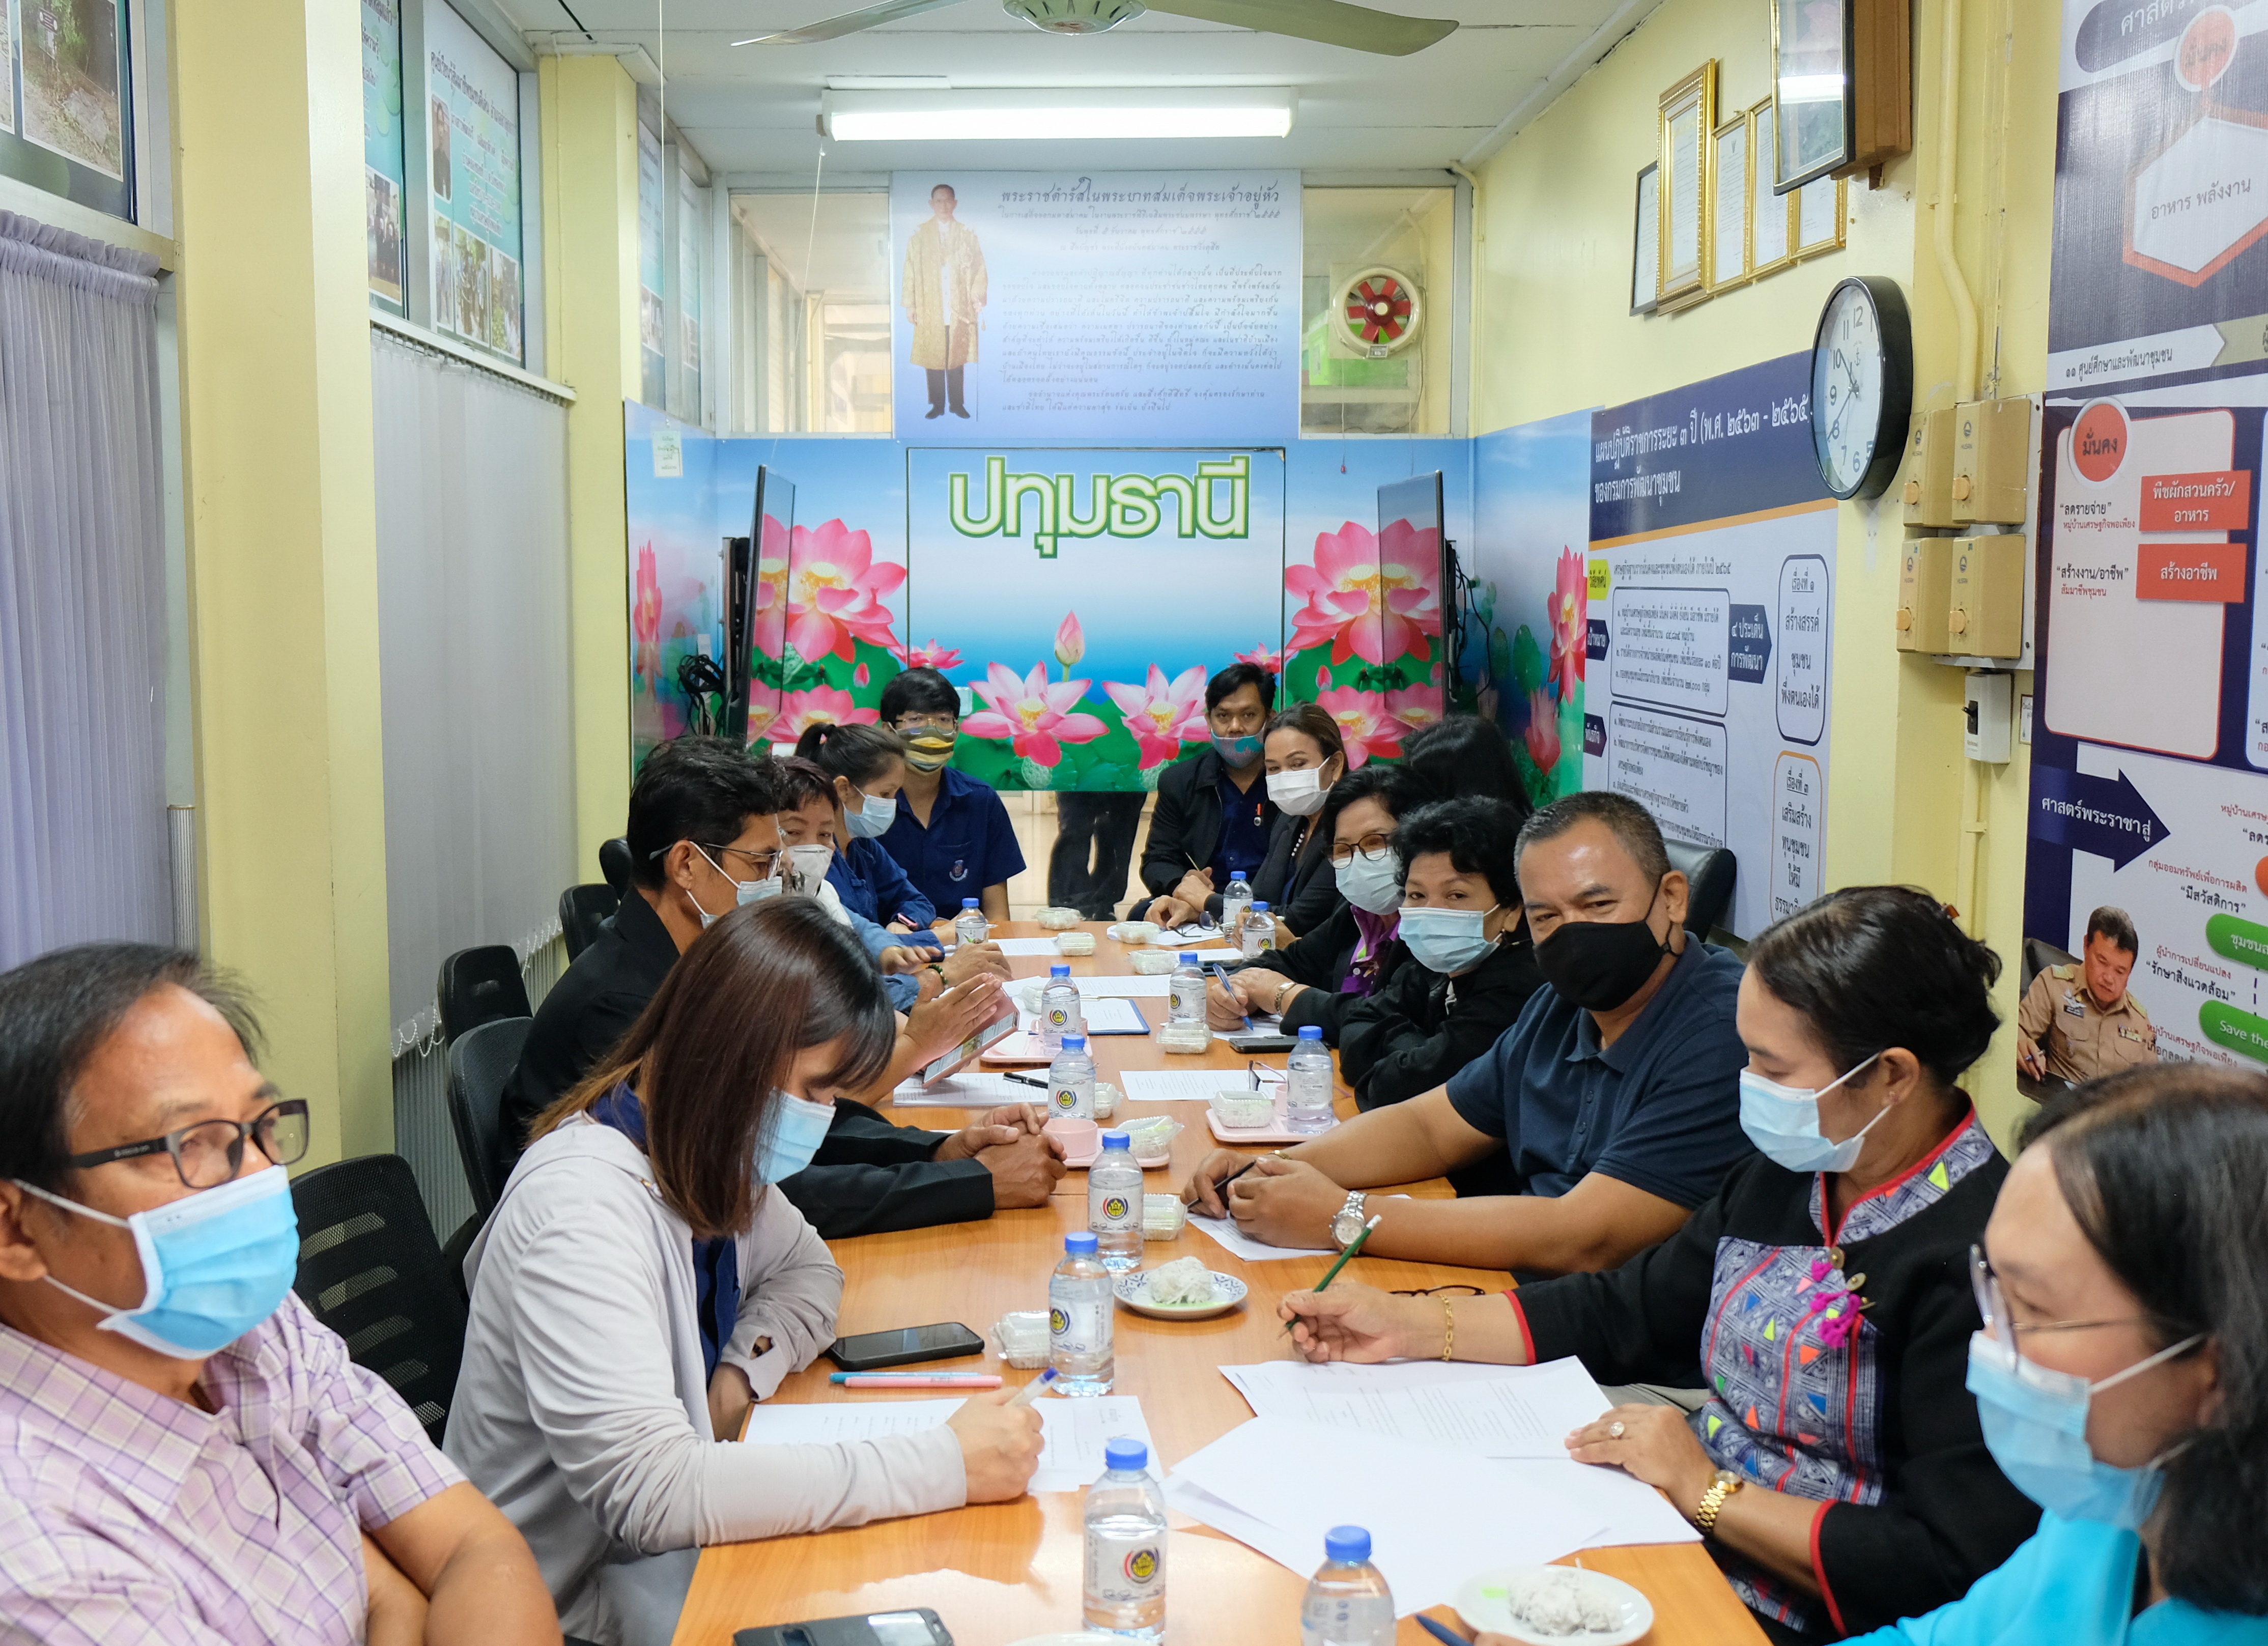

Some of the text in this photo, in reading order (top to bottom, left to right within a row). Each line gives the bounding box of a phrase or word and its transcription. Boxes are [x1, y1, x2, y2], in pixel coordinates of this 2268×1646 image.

[1002, 177, 1279, 209] พระราชดำรัสในพระบาทสมเด็จพระเจ้าอยู่หัว
[2150, 178, 2252, 220] อาหาร พลังงาน
[1853, 305, 1863, 329] 12
[1843, 319, 1849, 341] 11
[1833, 348, 1842, 370] 10
[2078, 349, 2173, 382] ศูนย์ศึกษาและพัฒนาชุมชน
[1829, 385, 1837, 406] 9
[1596, 425, 1678, 470] แผนปฏิบัติราชการระยะ
[1680, 428, 1687, 446] ๓
[1689, 407, 1697, 443] ปี
[1700, 411, 1724, 445] (พ.ศ.
[1727, 409, 1760, 437] ๒๕๖๓
[1772, 393, 1809, 427] ๒๕๖๕
[1832, 419, 1840, 440] 8
[2082, 428, 2118, 456] มั่นคง
[1841, 445, 1848, 466] 7
[1853, 451, 1860, 473] 6
[1595, 465, 1681, 506] ของกรมการพัฒนาชุมชน
[2152, 477, 2236, 500] พืชผักสวนครัว/
[949, 455, 1251, 558] ปทุมธานี
[2174, 508, 2209, 523] อาหาร
[2063, 519, 2136, 534] หมู่บ้านเศรษฐกิจพอเพียง
[1792, 567, 1808, 591] เรื่องที่
[2160, 563, 2217, 581] สร้างอาชีพ
[2061, 585, 2107, 600] สัมมาชีพชุมชน
[1739, 613, 1763, 640] ประเด็น
[1785, 607, 1820, 632] สร้างสรรค์
[1730, 645, 1763, 671] การพัฒนา
[1791, 652, 1811, 676] ชุมชน
[1781, 676, 1820, 709] พึ่งตนเองได้
[1787, 766, 1803, 790] เรื่องที่
[1782, 802, 1811, 829] เสริมสร้าง
[1782, 835, 1809, 862] ทุนชุมชน
[1788, 862, 1800, 889] ให้มี
[2148, 859, 2248, 893] กลุ่มออมทรัพย์เพื่อการผลิต
[2157, 944, 2231, 980] ผู้นำการเปลี่ยนแปลง
[2220, 1020, 2247, 1040] Save
